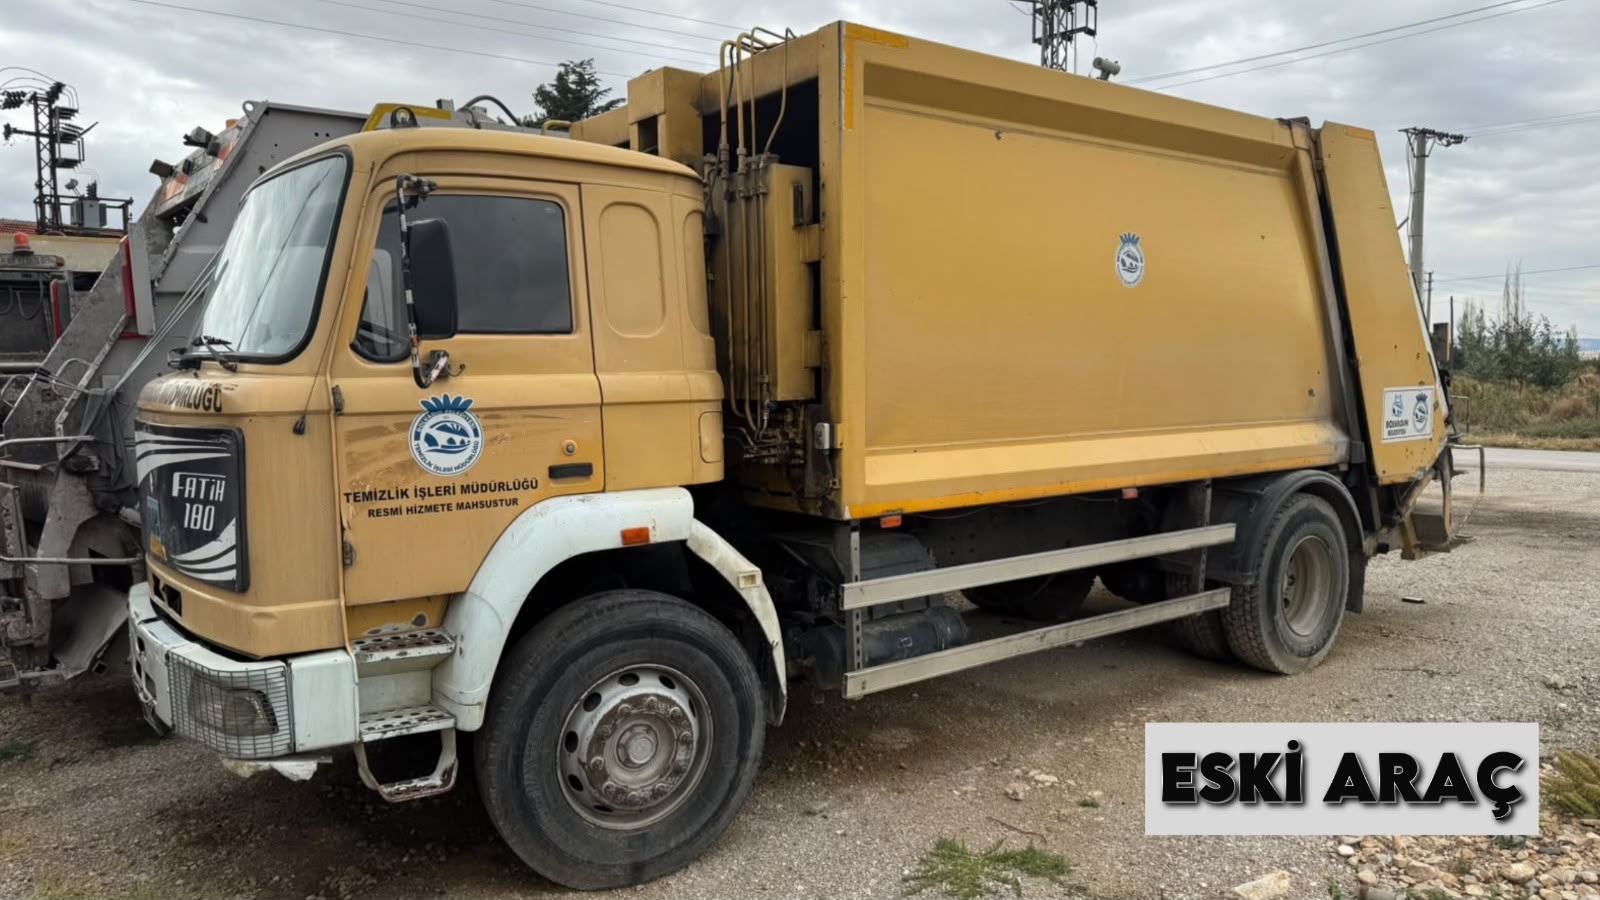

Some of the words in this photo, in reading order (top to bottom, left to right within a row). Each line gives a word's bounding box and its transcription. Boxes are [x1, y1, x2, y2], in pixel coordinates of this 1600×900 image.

[343, 486, 410, 504] TEMİZLİK
[413, 483, 457, 501] İŞLERİ
[460, 477, 539, 495] MÜDÜRLÜĞÜ
[183, 502, 215, 532] 180
[368, 504, 402, 518] RESMİ
[406, 502, 453, 515] HİZMETE
[456, 498, 519, 512] MAHSUSTUR
